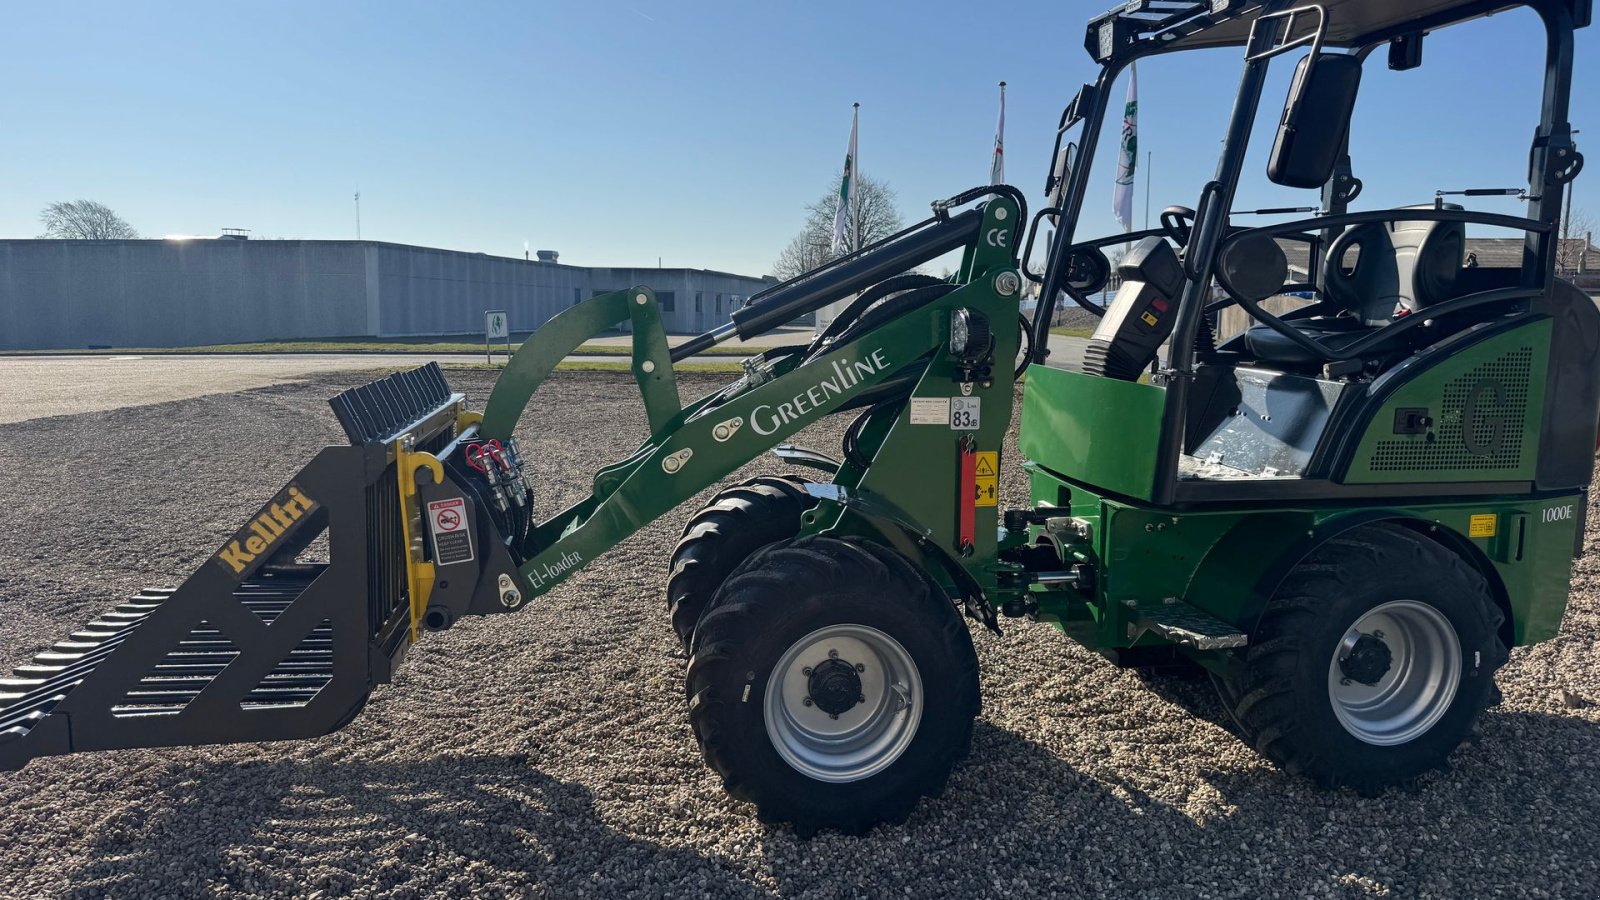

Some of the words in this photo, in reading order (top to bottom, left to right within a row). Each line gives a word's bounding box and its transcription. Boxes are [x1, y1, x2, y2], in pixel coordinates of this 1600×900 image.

[953, 411, 970, 427] 83
[1542, 504, 1573, 523] 1000E
[219, 486, 314, 573] Kellfri
